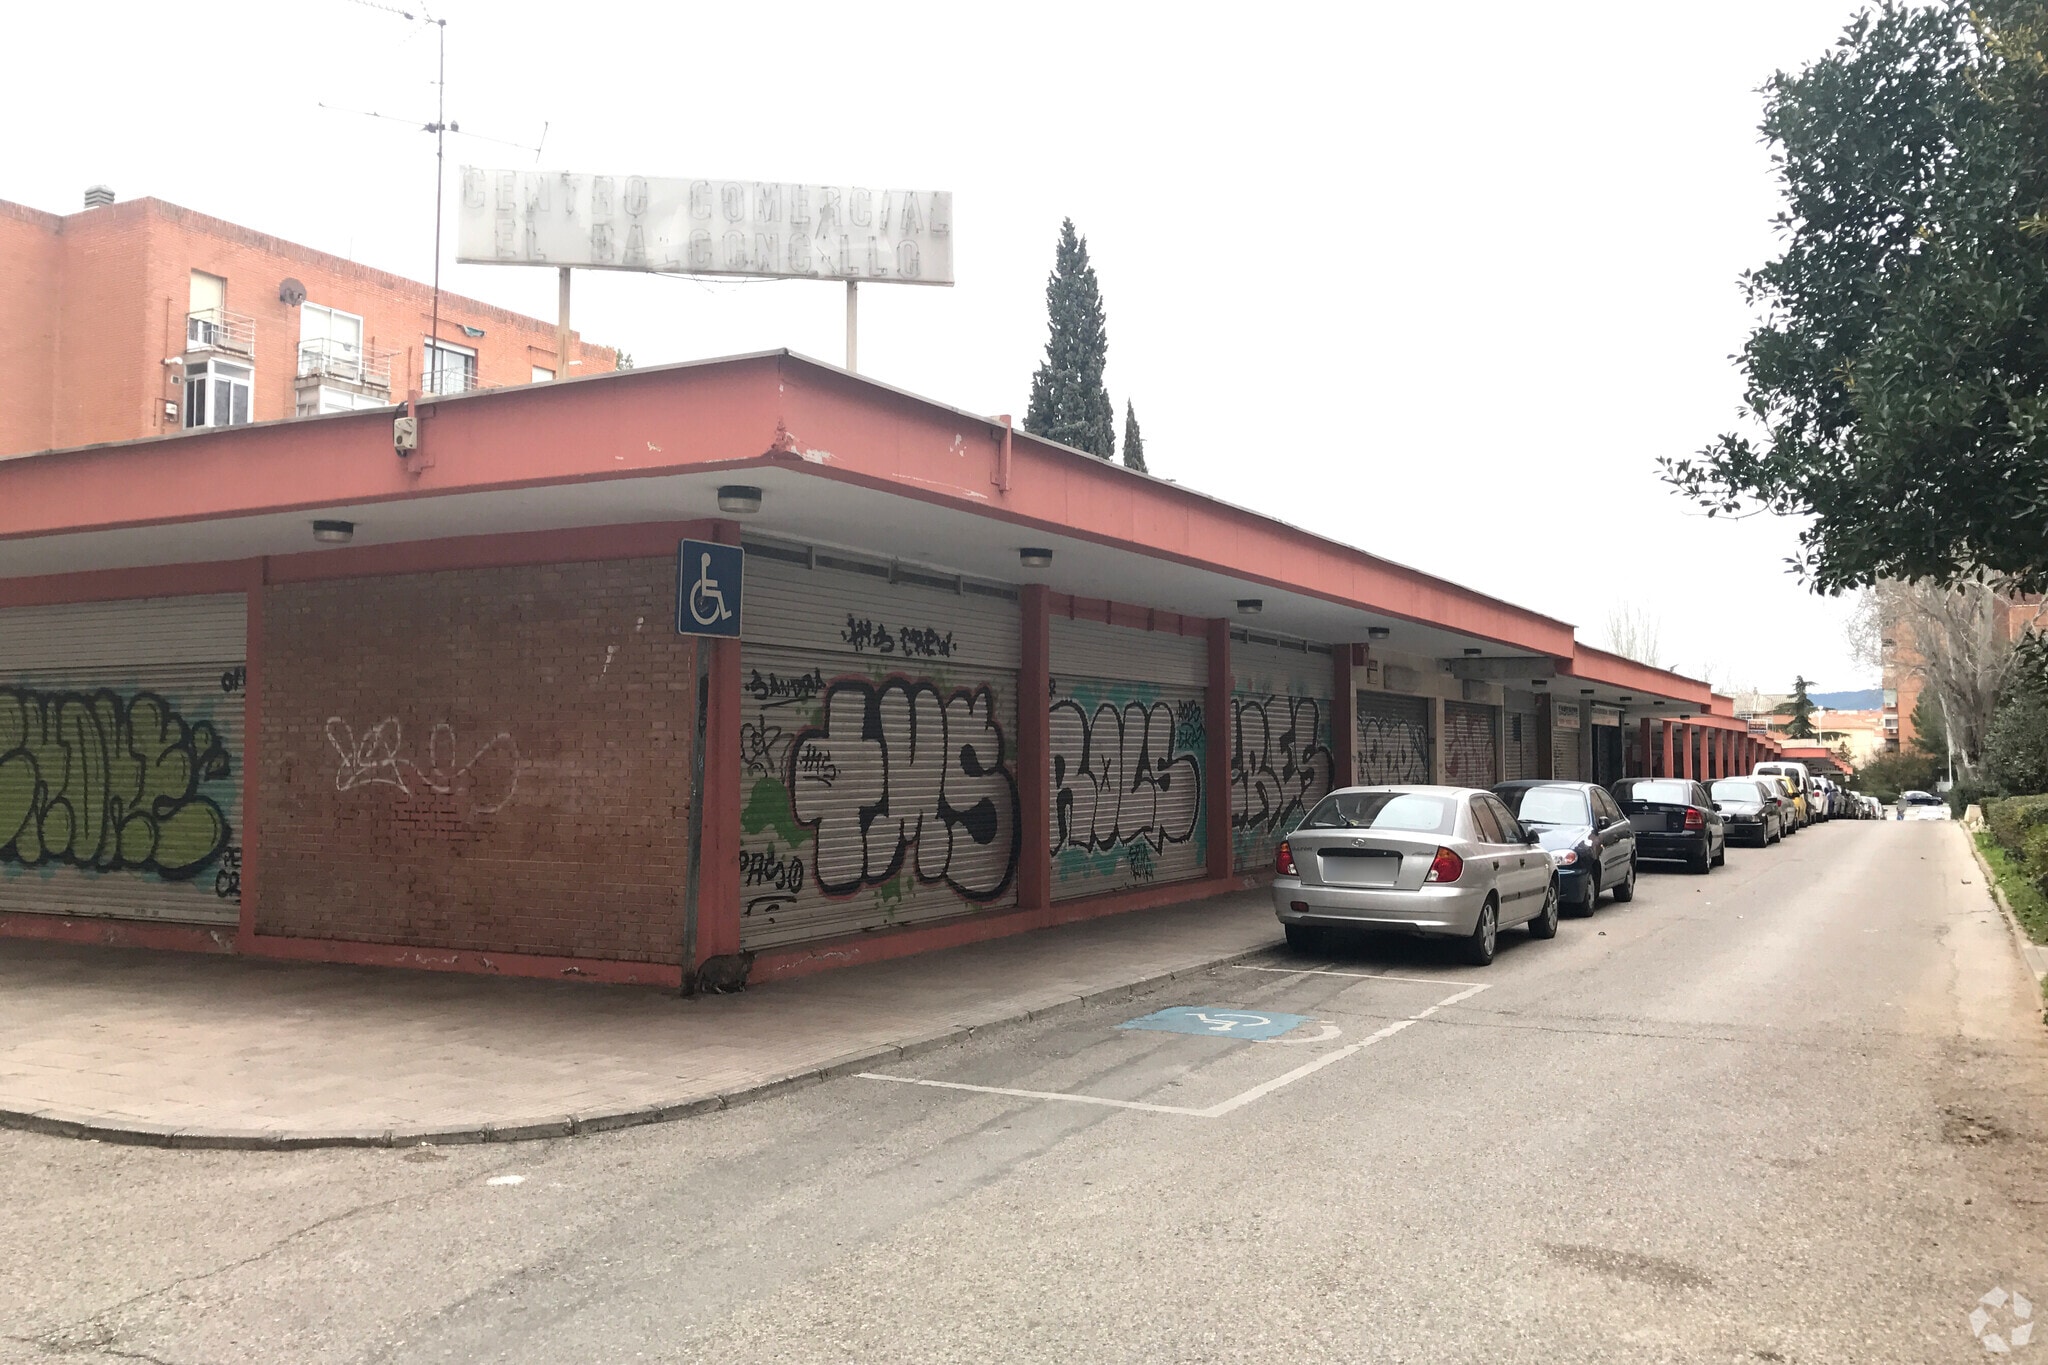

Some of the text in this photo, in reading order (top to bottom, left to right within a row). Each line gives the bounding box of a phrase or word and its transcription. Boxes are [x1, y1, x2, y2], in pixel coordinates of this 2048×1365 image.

[462, 167, 950, 234] CENTRO COMERCIAL
[495, 217, 547, 262] EL
